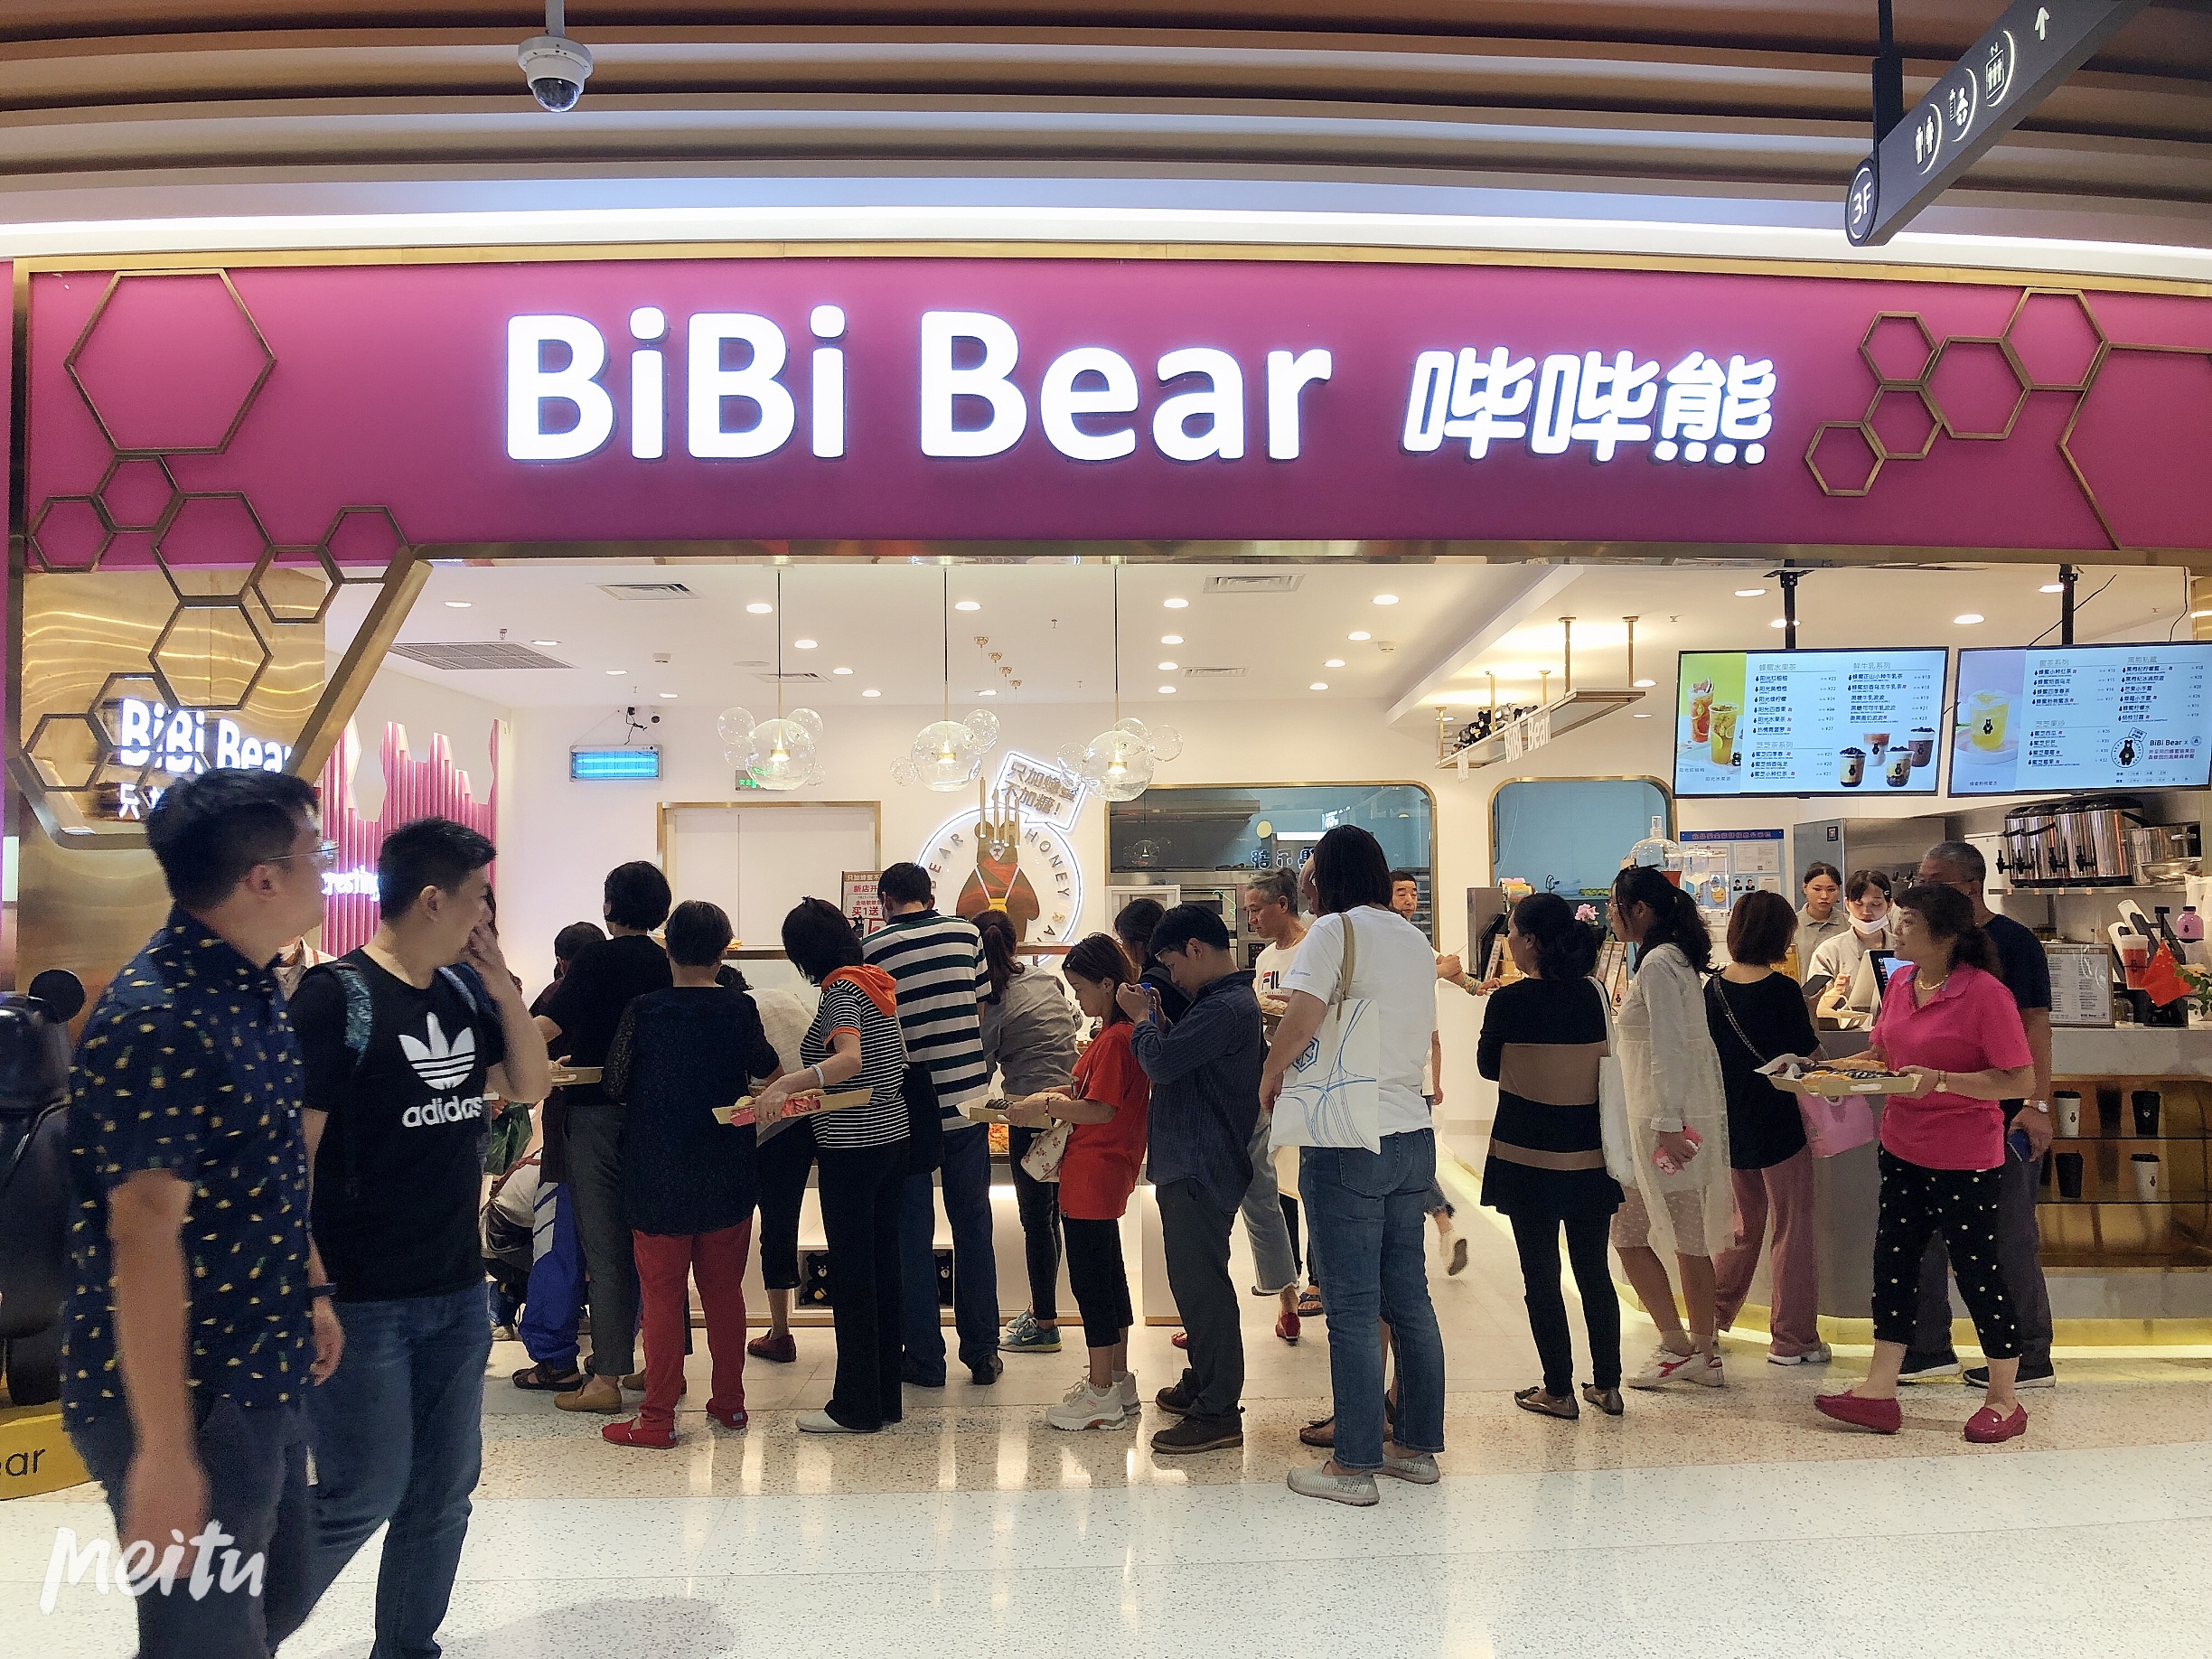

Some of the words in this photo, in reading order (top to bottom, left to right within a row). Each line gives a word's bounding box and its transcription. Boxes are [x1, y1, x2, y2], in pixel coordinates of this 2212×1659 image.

[1853, 181, 1871, 224] 3F
[506, 305, 846, 461] BiBi
[921, 310, 1333, 463] Bear
[1403, 346, 1777, 464] 哗哗熊
[1853, 662, 1891, 670] 鲜牛乳系列
[120, 697, 206, 774] BiBi
[1504, 723, 1523, 764] BiBi
[1527, 715, 1551, 752] Bear
[1008, 761, 1076, 802] 只加蜂蜜
[1025, 828, 1070, 897] HONEY
[402, 1095, 483, 1128] adidas
[0, 1448, 46, 1476] ar
